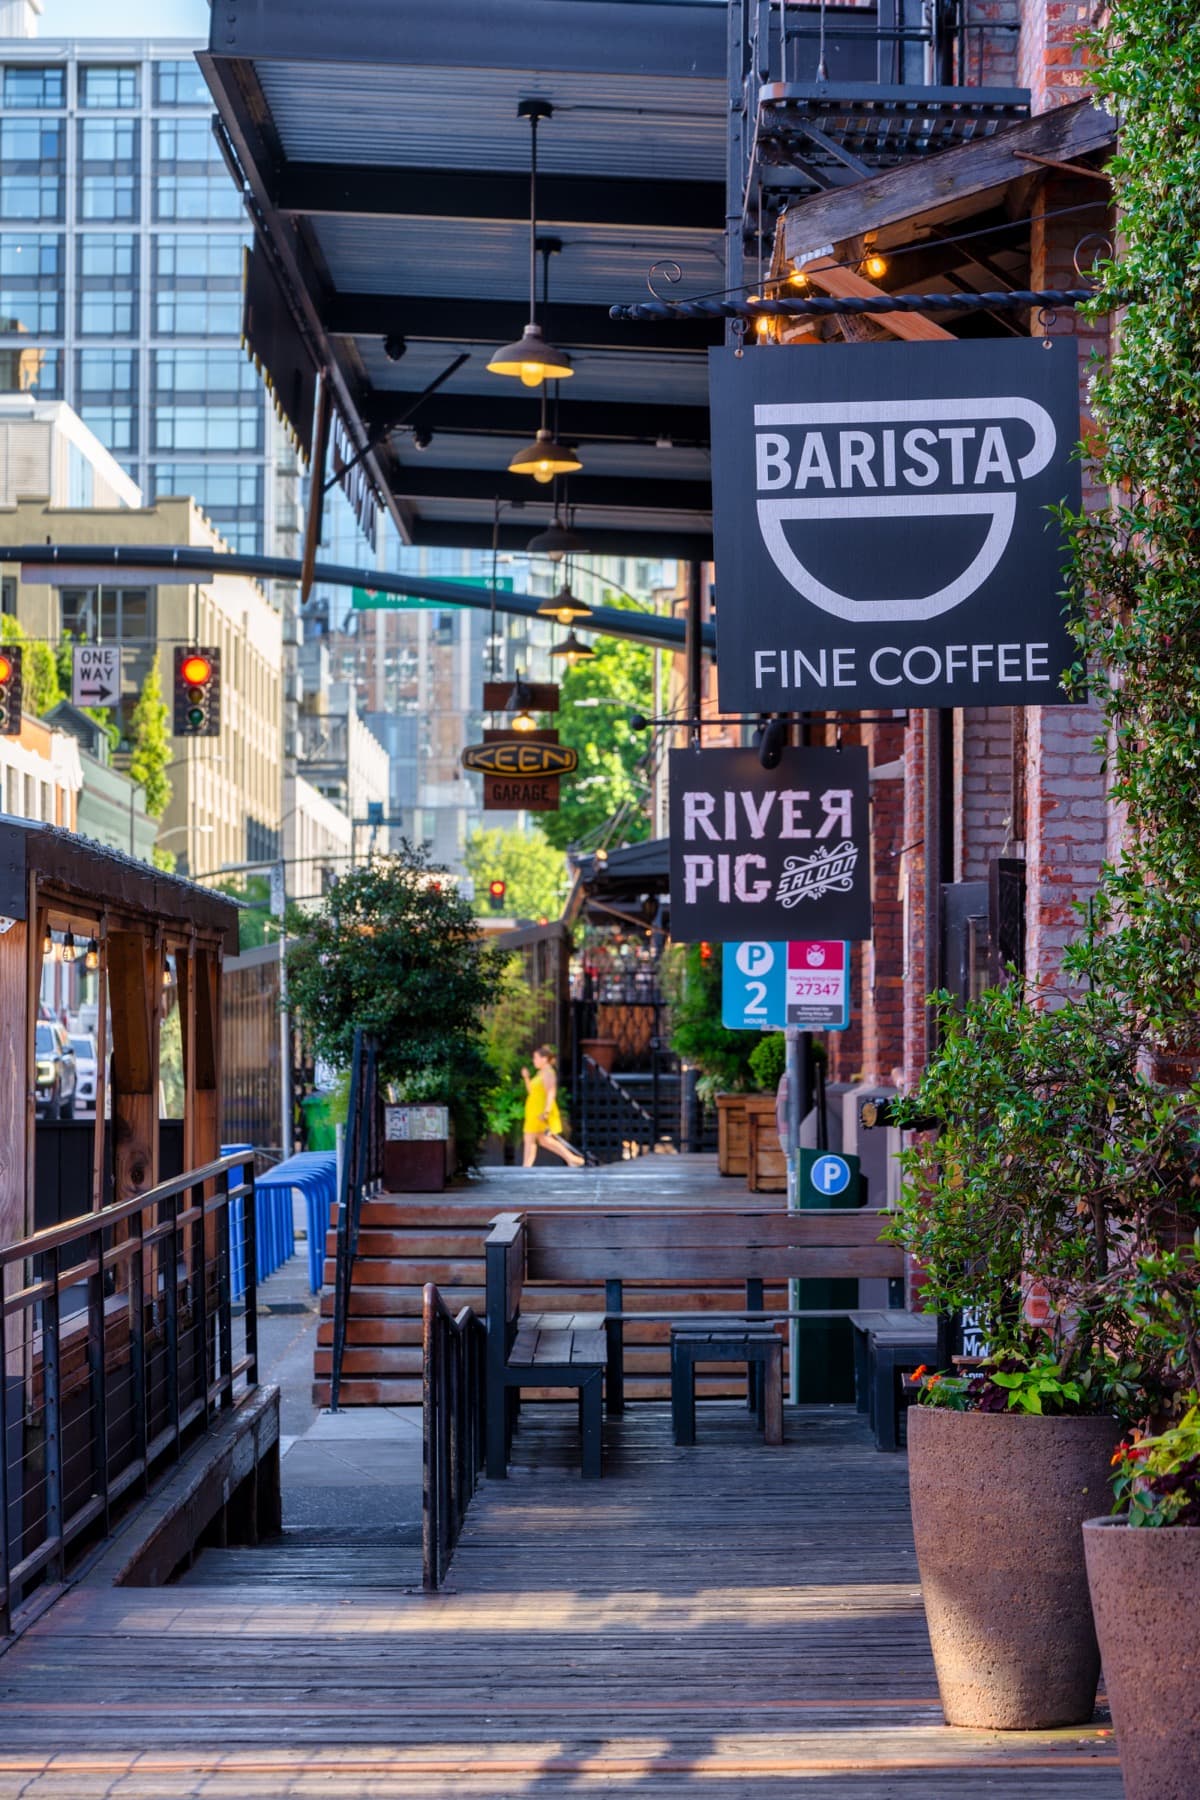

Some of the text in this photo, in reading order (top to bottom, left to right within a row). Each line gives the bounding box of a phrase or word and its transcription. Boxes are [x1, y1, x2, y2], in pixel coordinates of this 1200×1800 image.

[755, 426, 1016, 490] BARISTA
[80, 650, 113, 665] ONE
[754, 643, 1050, 688] FINE COFFEE
[80, 667, 114, 681] WAY
[468, 745, 571, 772] KEEN
[492, 785, 550, 801] GARAGE
[682, 789, 854, 841] RIVER
[683, 853, 859, 905] PIG SALOON
[747, 945, 766, 970] P
[743, 981, 768, 1014] 2
[796, 983, 840, 996] 27347
[823, 1162, 842, 1190] P
